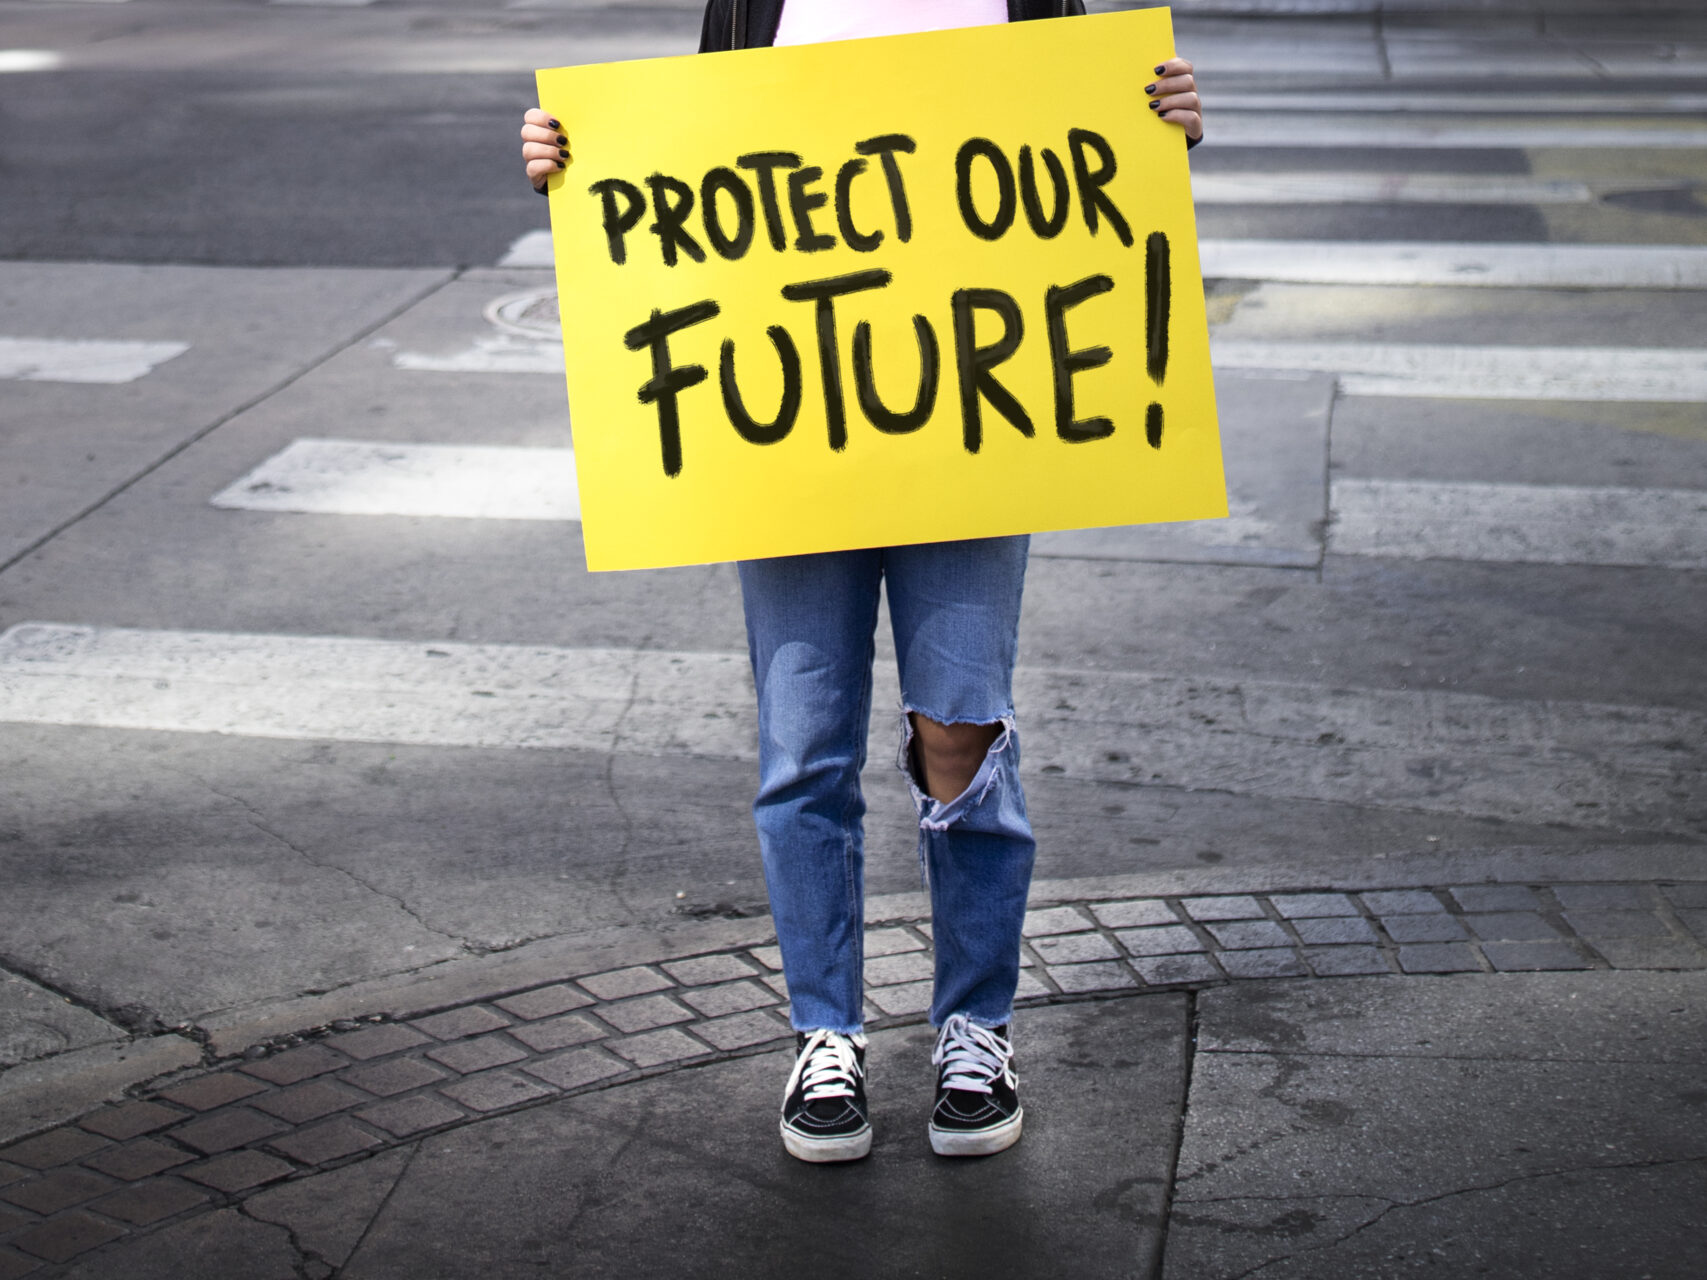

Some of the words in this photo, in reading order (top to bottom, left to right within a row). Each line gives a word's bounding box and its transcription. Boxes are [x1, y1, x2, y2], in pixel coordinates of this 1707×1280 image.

[588, 133, 917, 267] PROTECT
[954, 127, 1135, 248] OUR
[623, 231, 1172, 479] FUTURE!
